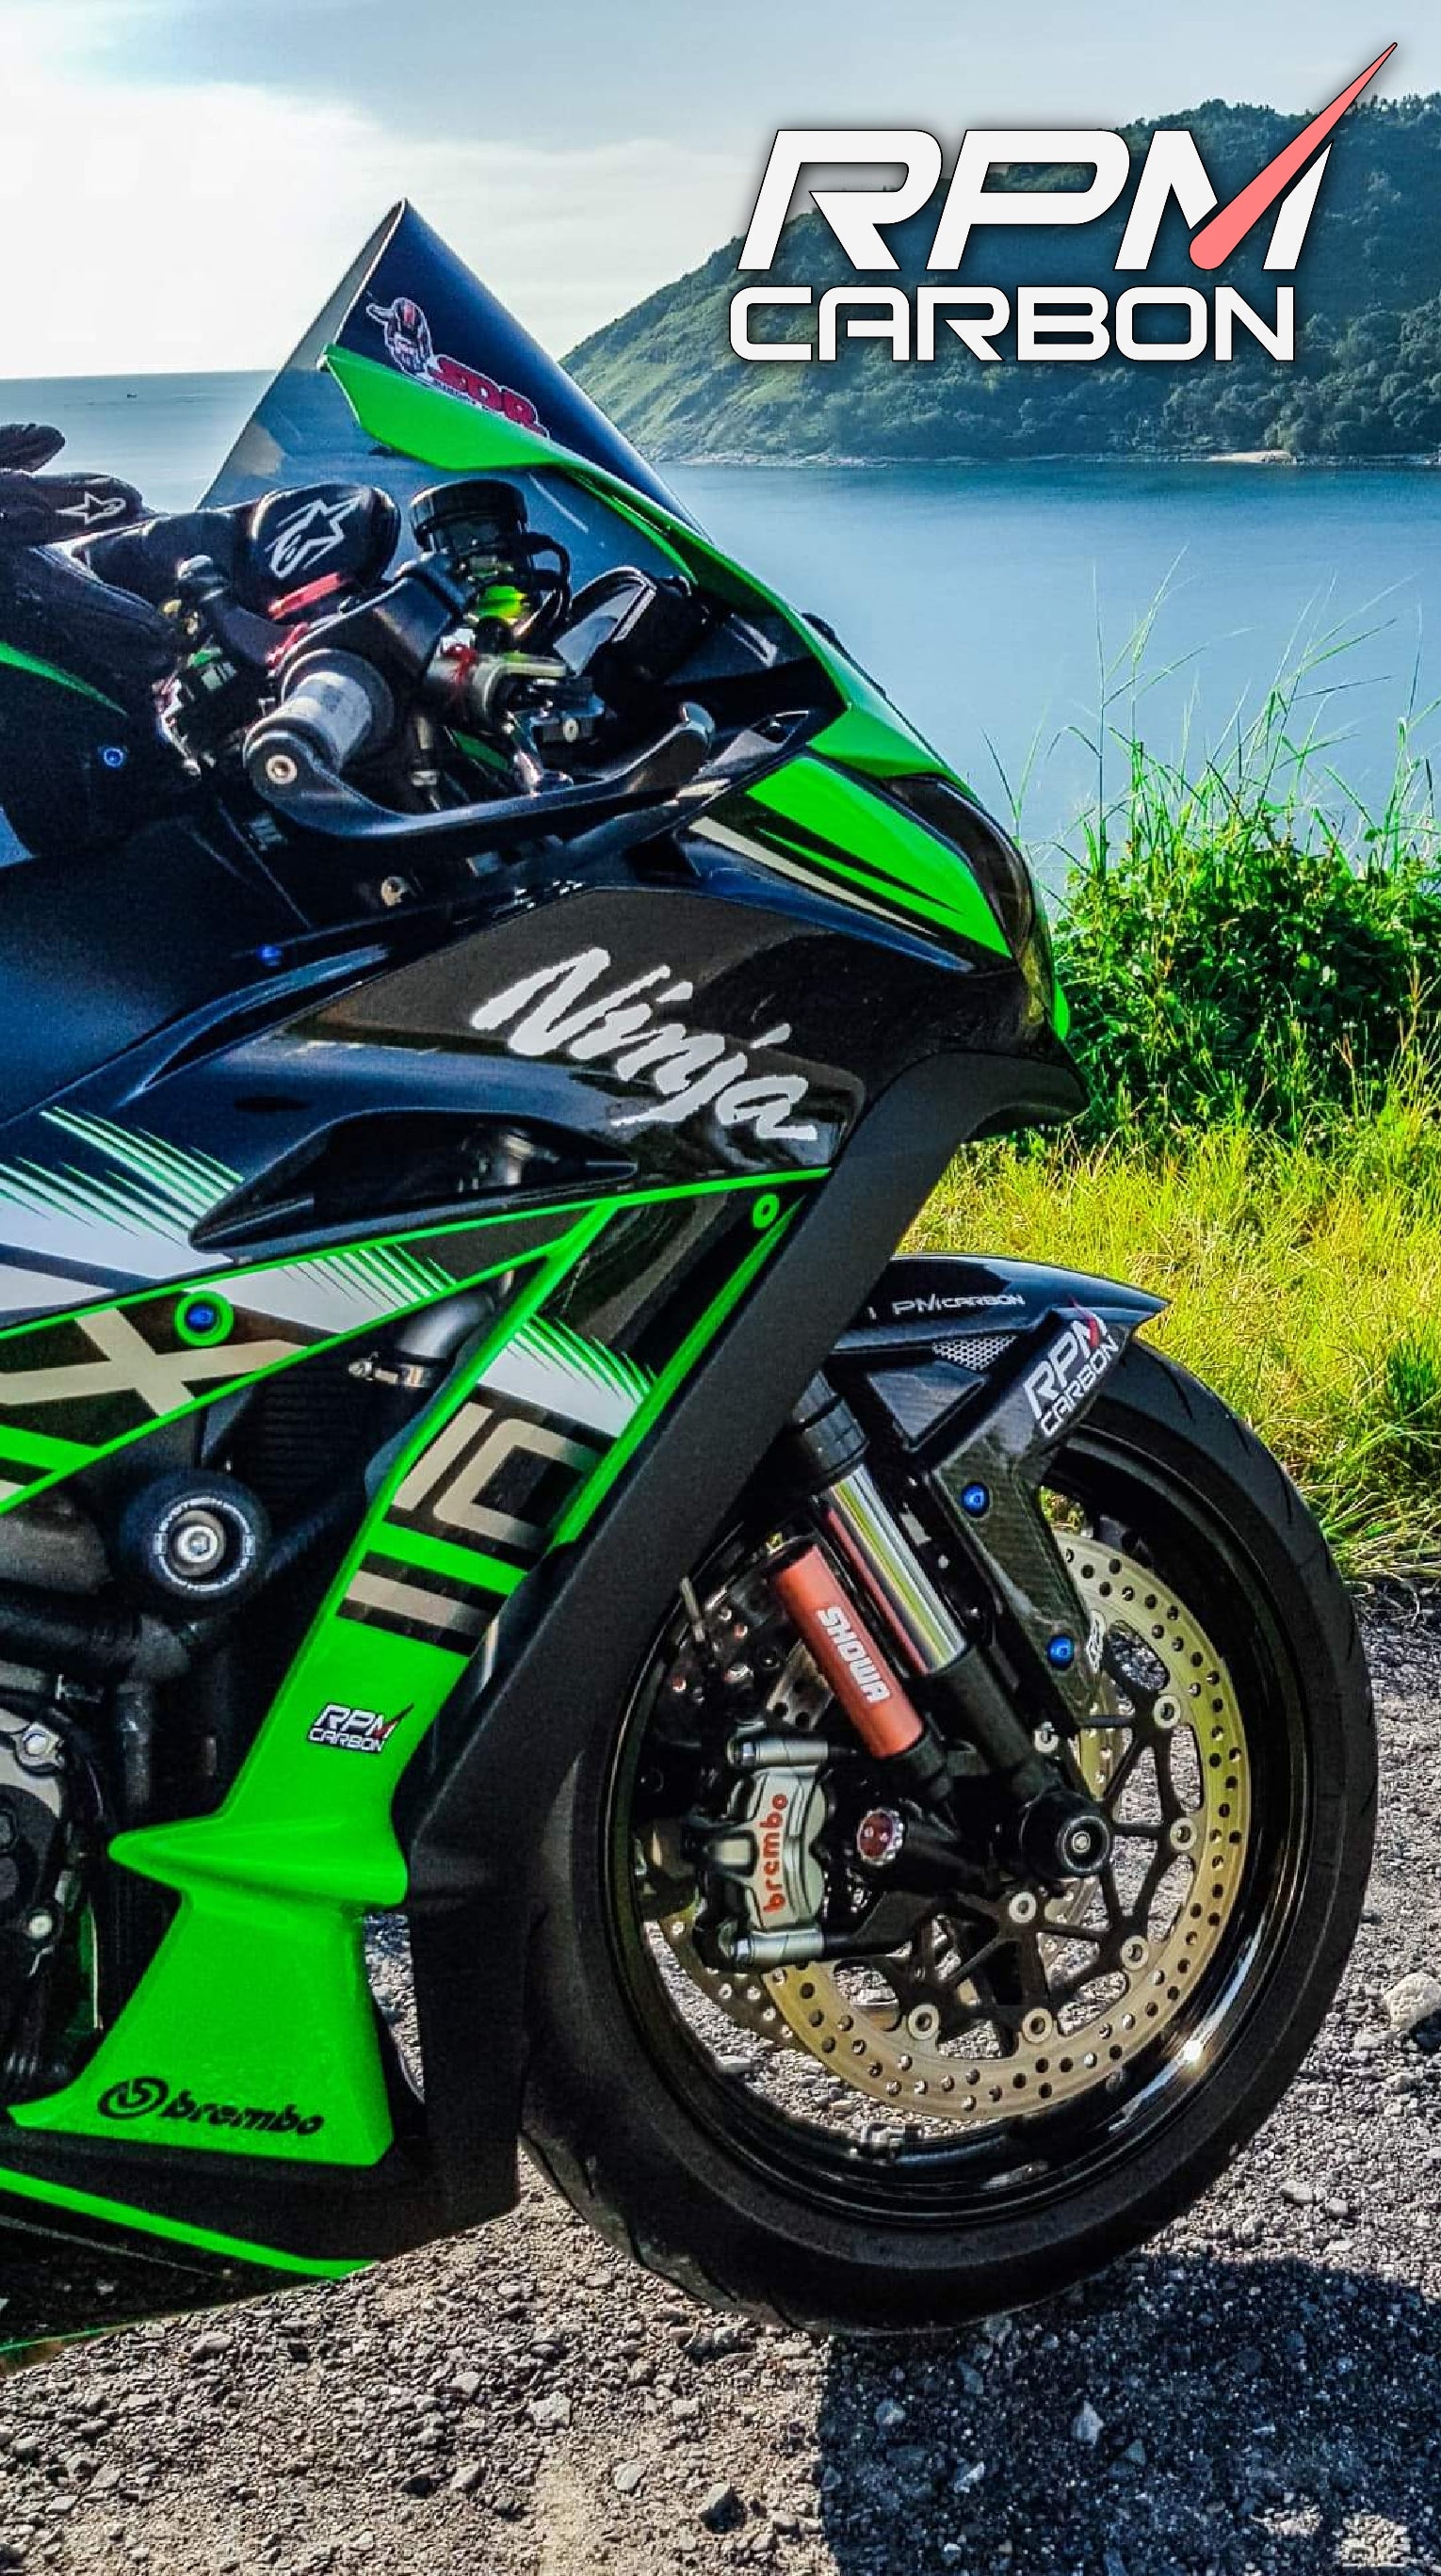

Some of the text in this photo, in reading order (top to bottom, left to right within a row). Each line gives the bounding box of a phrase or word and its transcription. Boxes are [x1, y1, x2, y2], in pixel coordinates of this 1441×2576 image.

[471, 947, 819, 1141] Ninja
[1024, 1295, 1108, 1419] RPM
[1041, 1334, 1119, 1437] CARBON
[817, 1606, 890, 1703] SHOWA
[308, 1728, 386, 1752] CARBON
[314, 1702, 413, 1739] RPM
[759, 1794, 788, 1913] brembo
[160, 2089, 325, 2135] brembo
